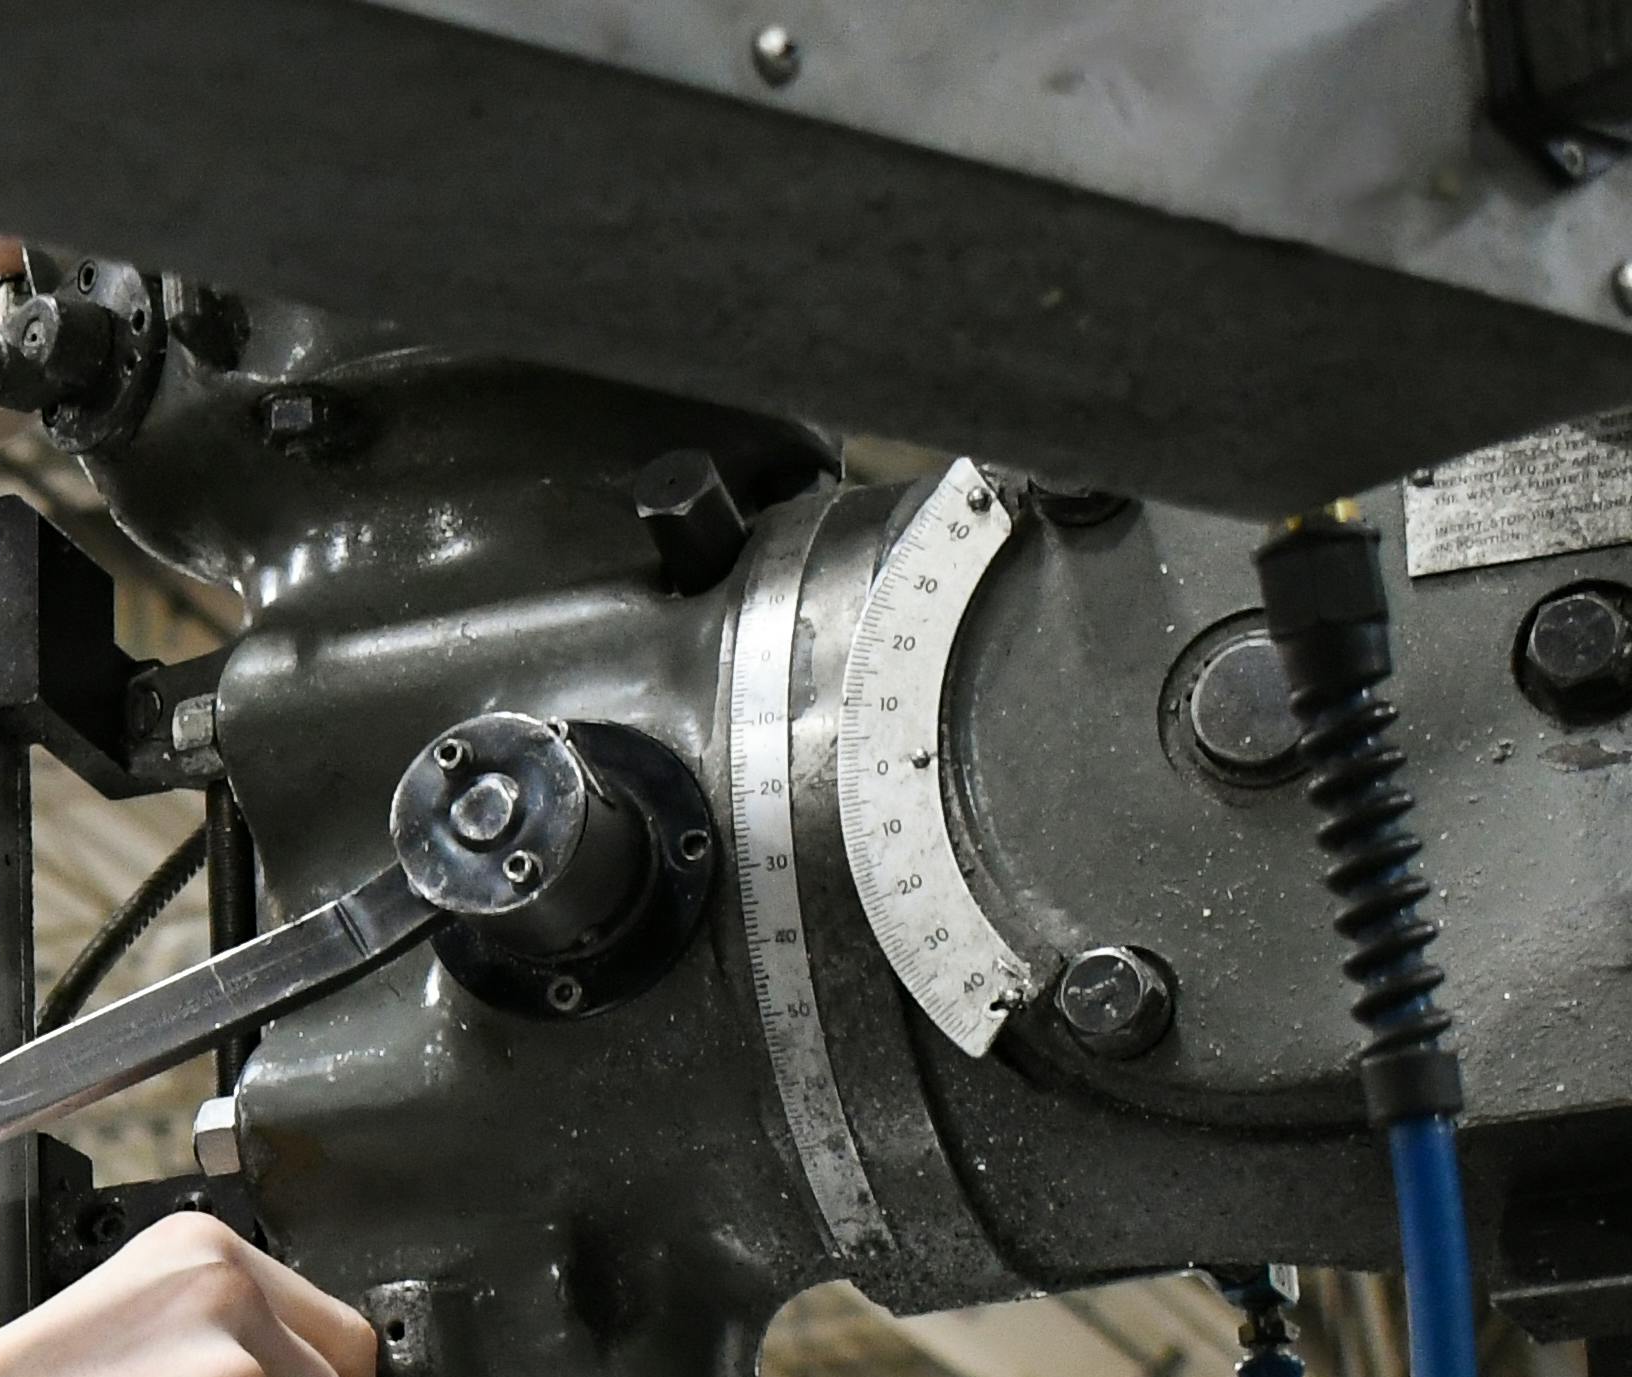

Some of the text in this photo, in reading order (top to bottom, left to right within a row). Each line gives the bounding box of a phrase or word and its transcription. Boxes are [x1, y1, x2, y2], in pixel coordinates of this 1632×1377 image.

[946, 520, 971, 540] 40
[912, 574, 939, 595] 30
[768, 593, 786, 606] 10
[891, 634, 917, 652] 20
[760, 650, 772, 663] 0
[879, 695, 899, 713] 10
[757, 710, 776, 726] 10
[876, 759, 889, 776] 0
[759, 778, 783, 796] 20
[882, 818, 903, 837] 10
[765, 853, 789, 873] 30
[896, 872, 923, 896] 20
[774, 928, 798, 945] 40
[923, 926, 950, 951] 30
[962, 971, 986, 996] 40
[787, 1001, 811, 1019] 50
